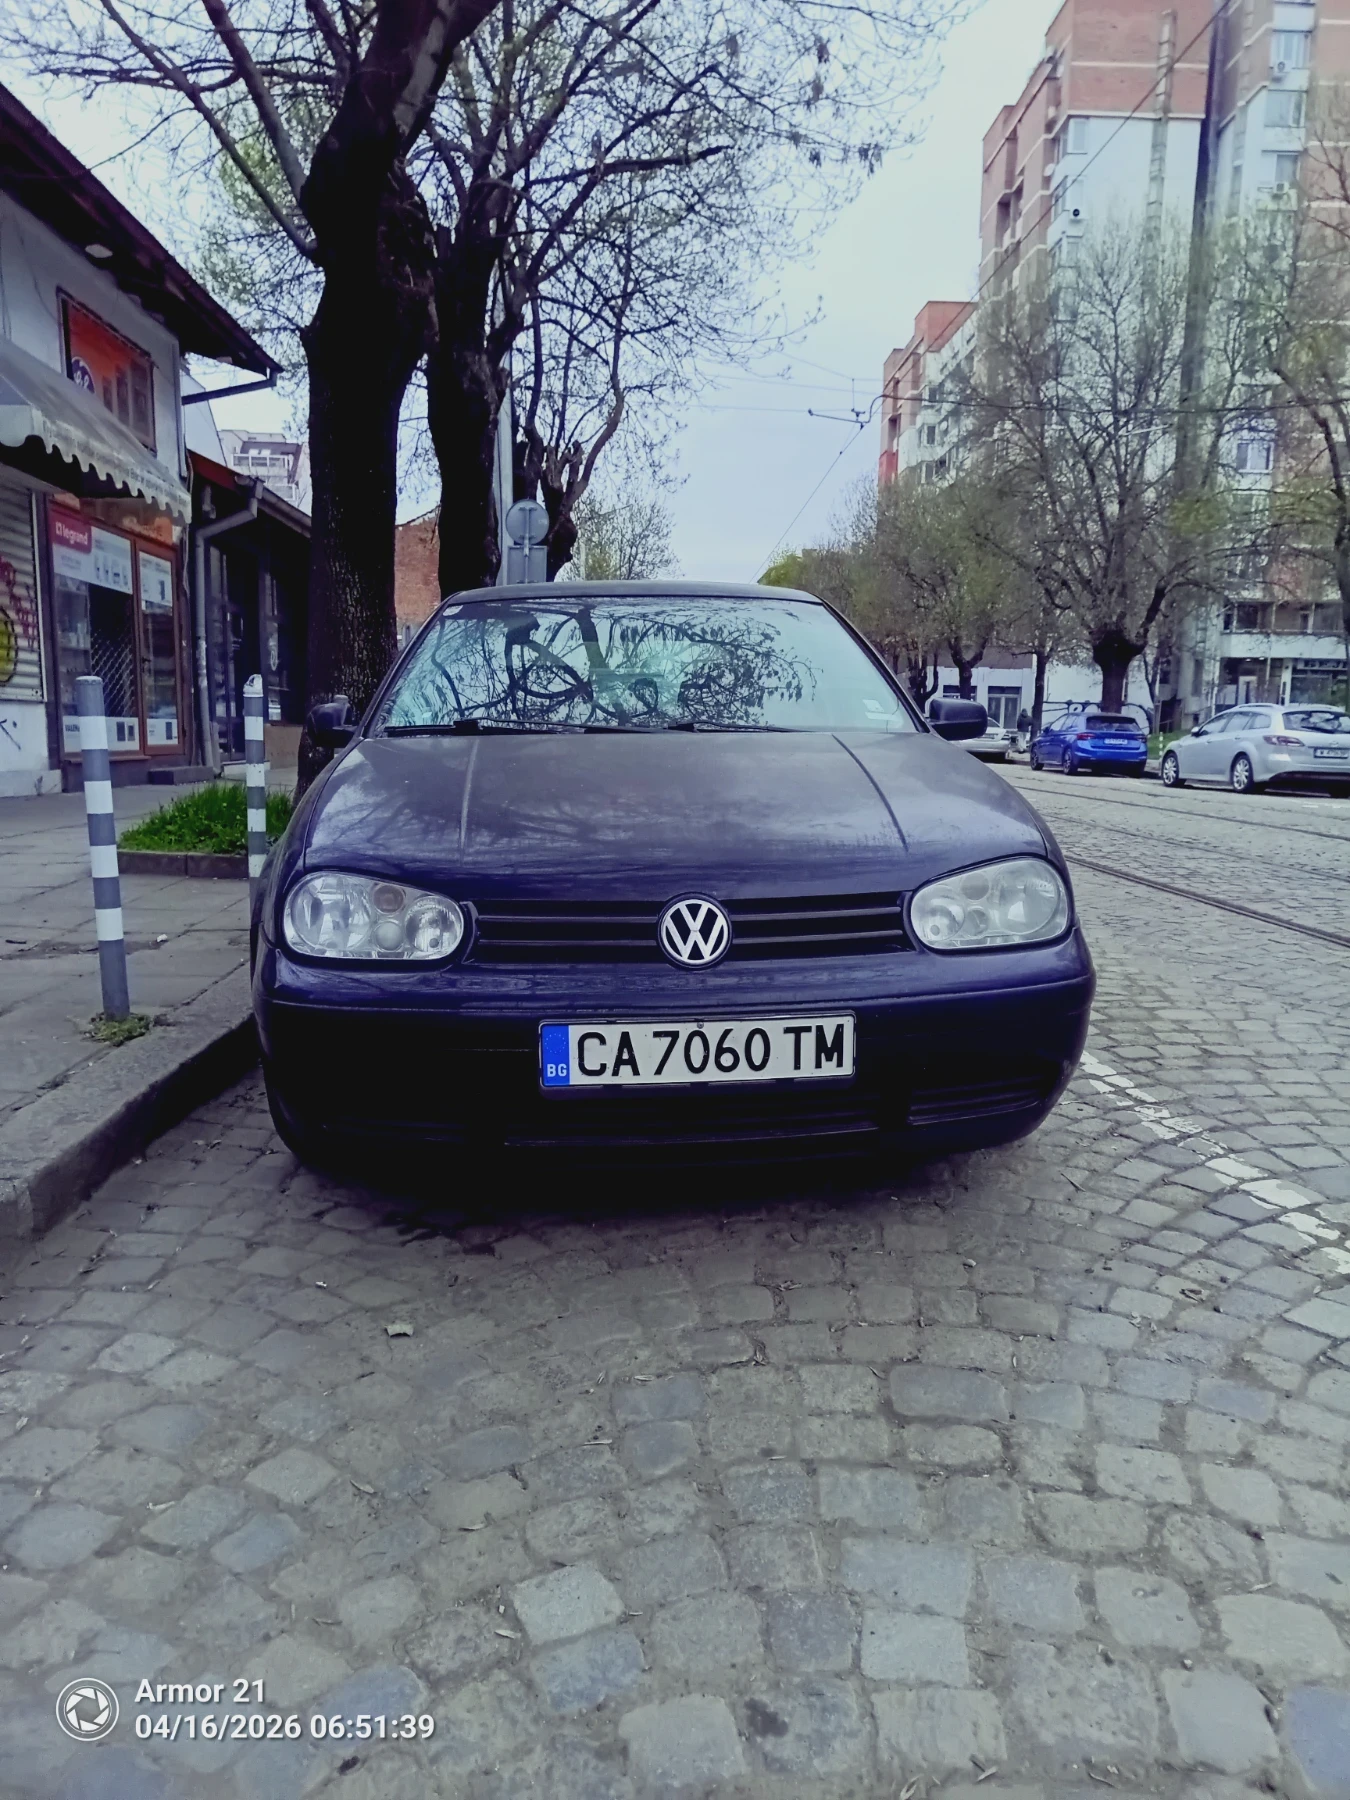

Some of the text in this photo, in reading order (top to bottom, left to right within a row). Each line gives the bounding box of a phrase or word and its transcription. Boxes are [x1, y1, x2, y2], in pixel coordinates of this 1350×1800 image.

[62, 523, 88, 545] legrand
[577, 1023, 845, 1077] CA 7060 TM
[546, 1063, 567, 1077] BG
